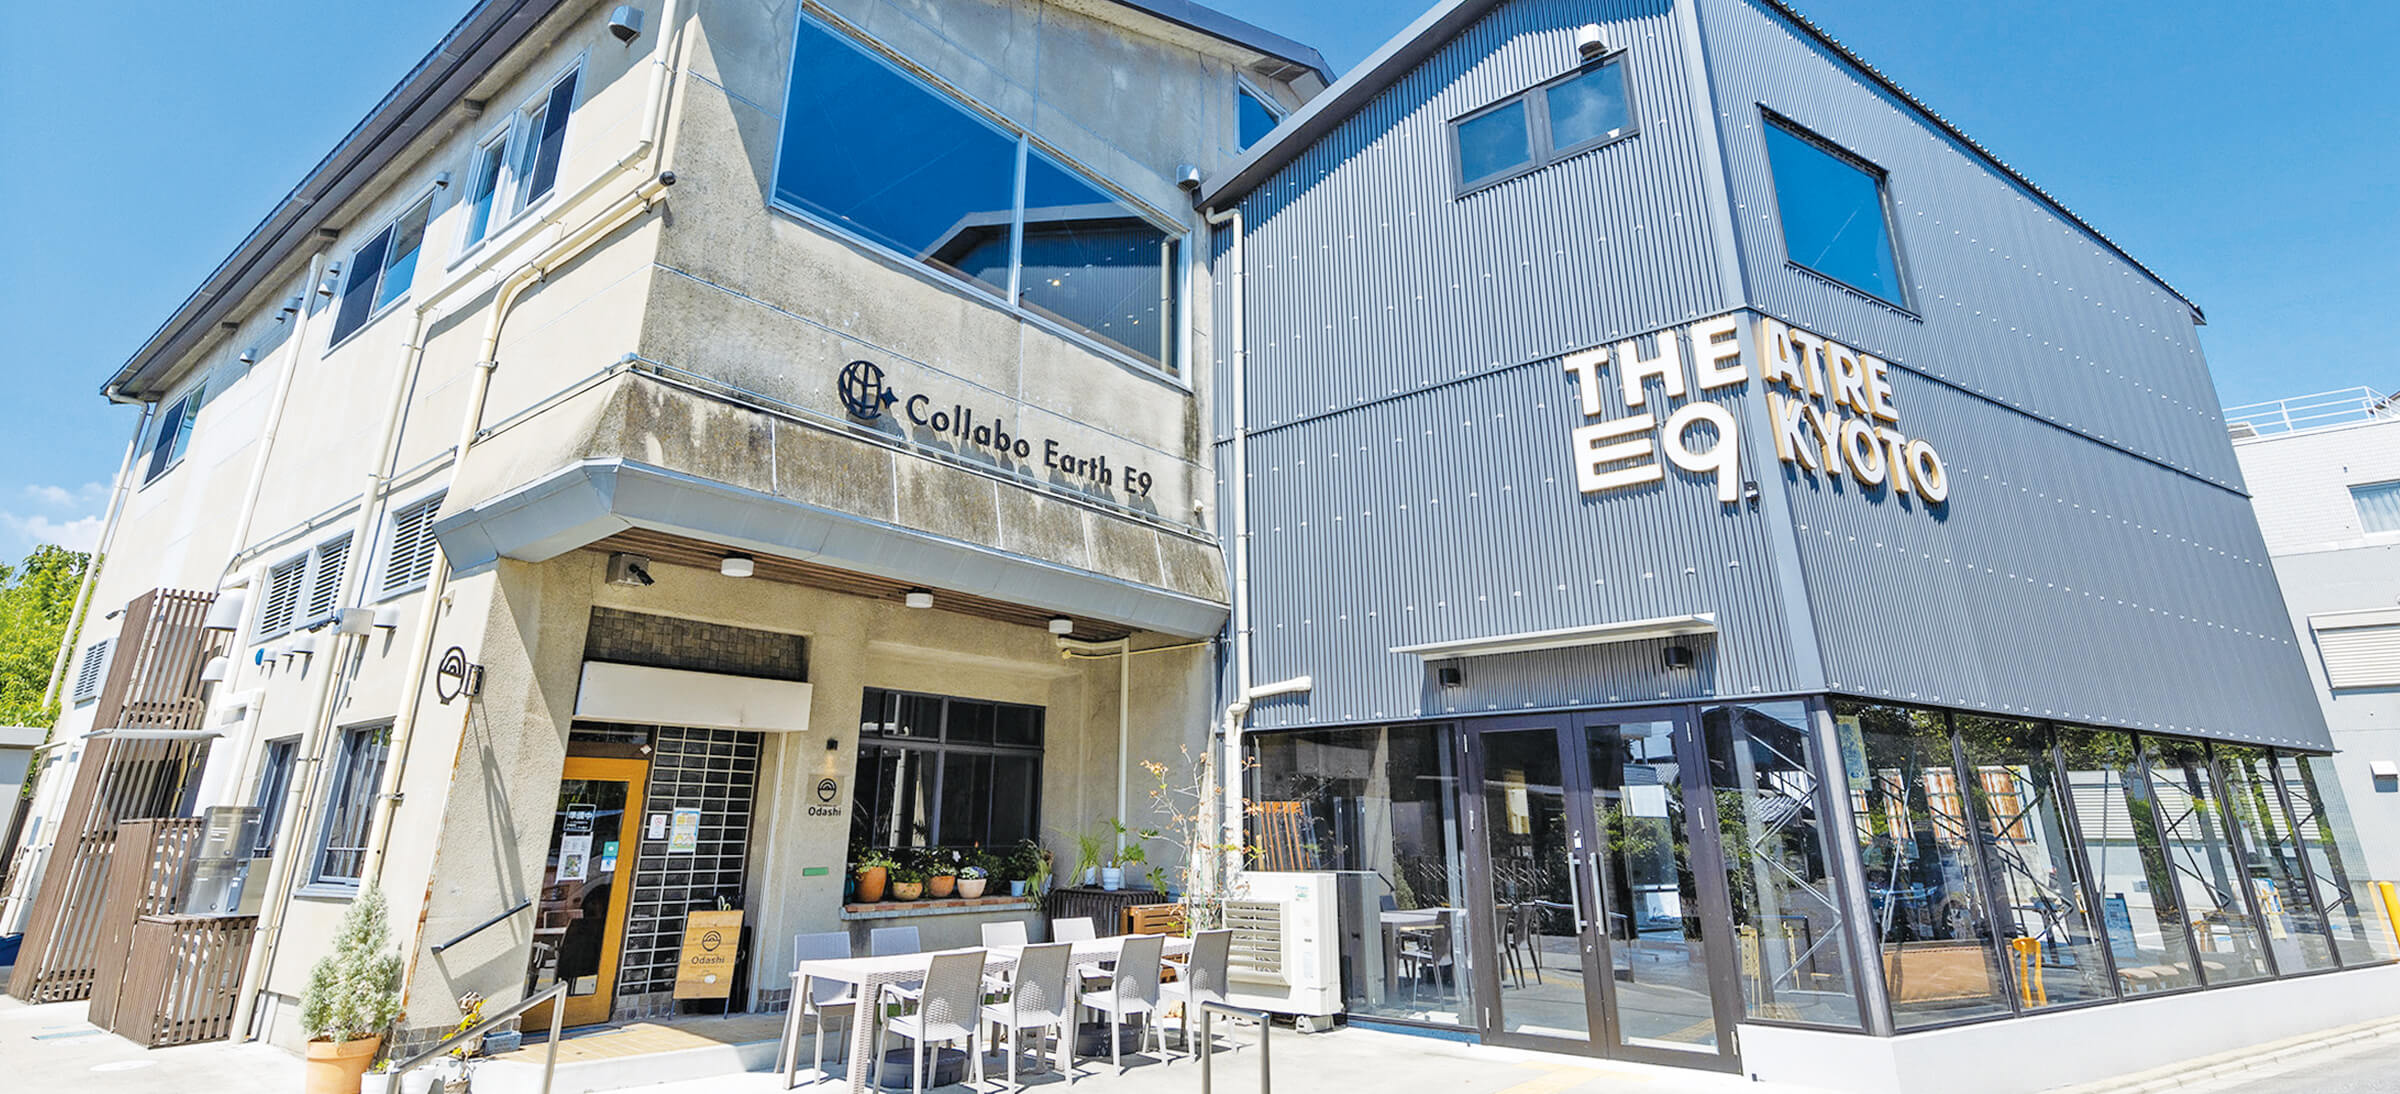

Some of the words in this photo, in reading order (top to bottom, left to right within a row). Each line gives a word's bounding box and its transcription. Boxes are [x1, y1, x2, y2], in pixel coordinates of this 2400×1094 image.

[906, 394, 1031, 458] Collabo
[1044, 439, 1112, 486] Earth
[1123, 466, 1153, 498] E9
[1572, 401, 1739, 502] E9
[1767, 390, 1949, 503] KYOTO
[808, 806, 842, 817] Odashi
[691, 955, 725, 965] Odashi
